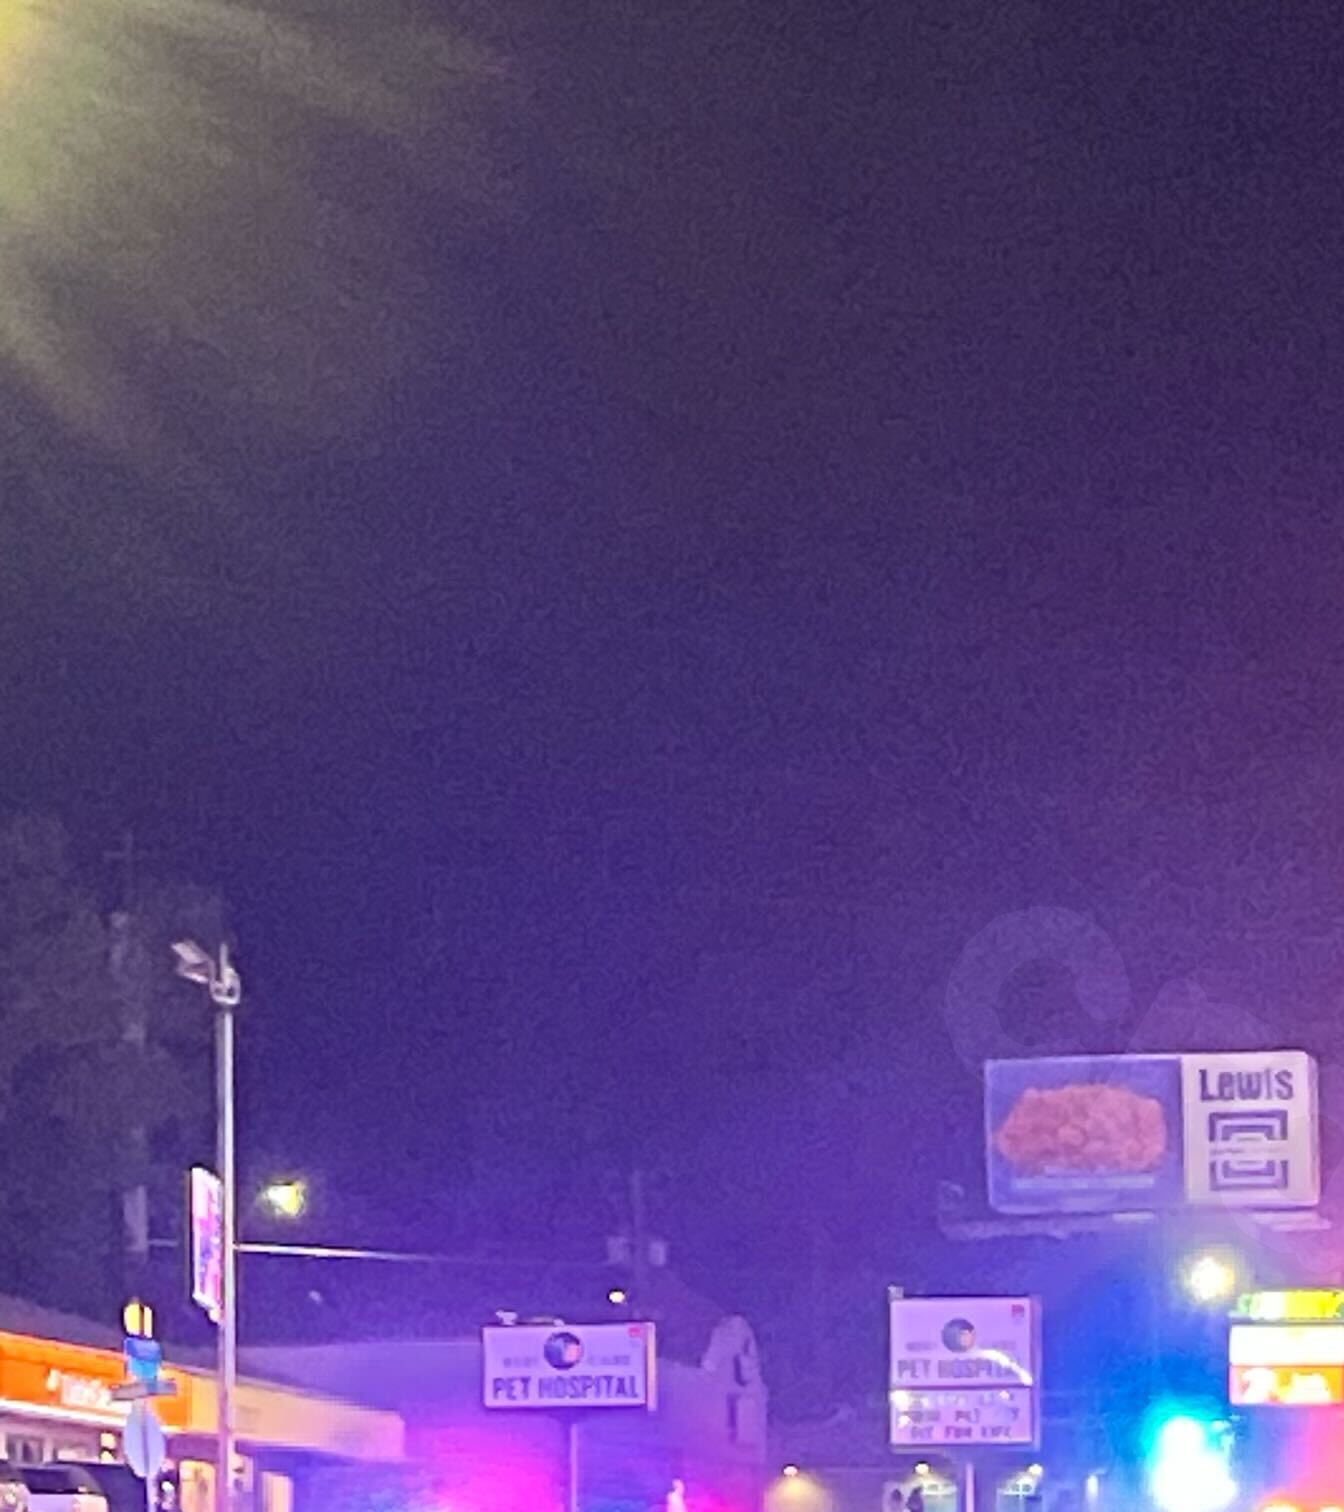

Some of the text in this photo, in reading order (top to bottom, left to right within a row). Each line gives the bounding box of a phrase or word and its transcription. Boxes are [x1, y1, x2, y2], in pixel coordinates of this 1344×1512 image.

[1199, 1067, 1294, 1101] Lewis
[897, 1359, 930, 1378] PET
[492, 1375, 639, 1400] PET HOSPITAL
